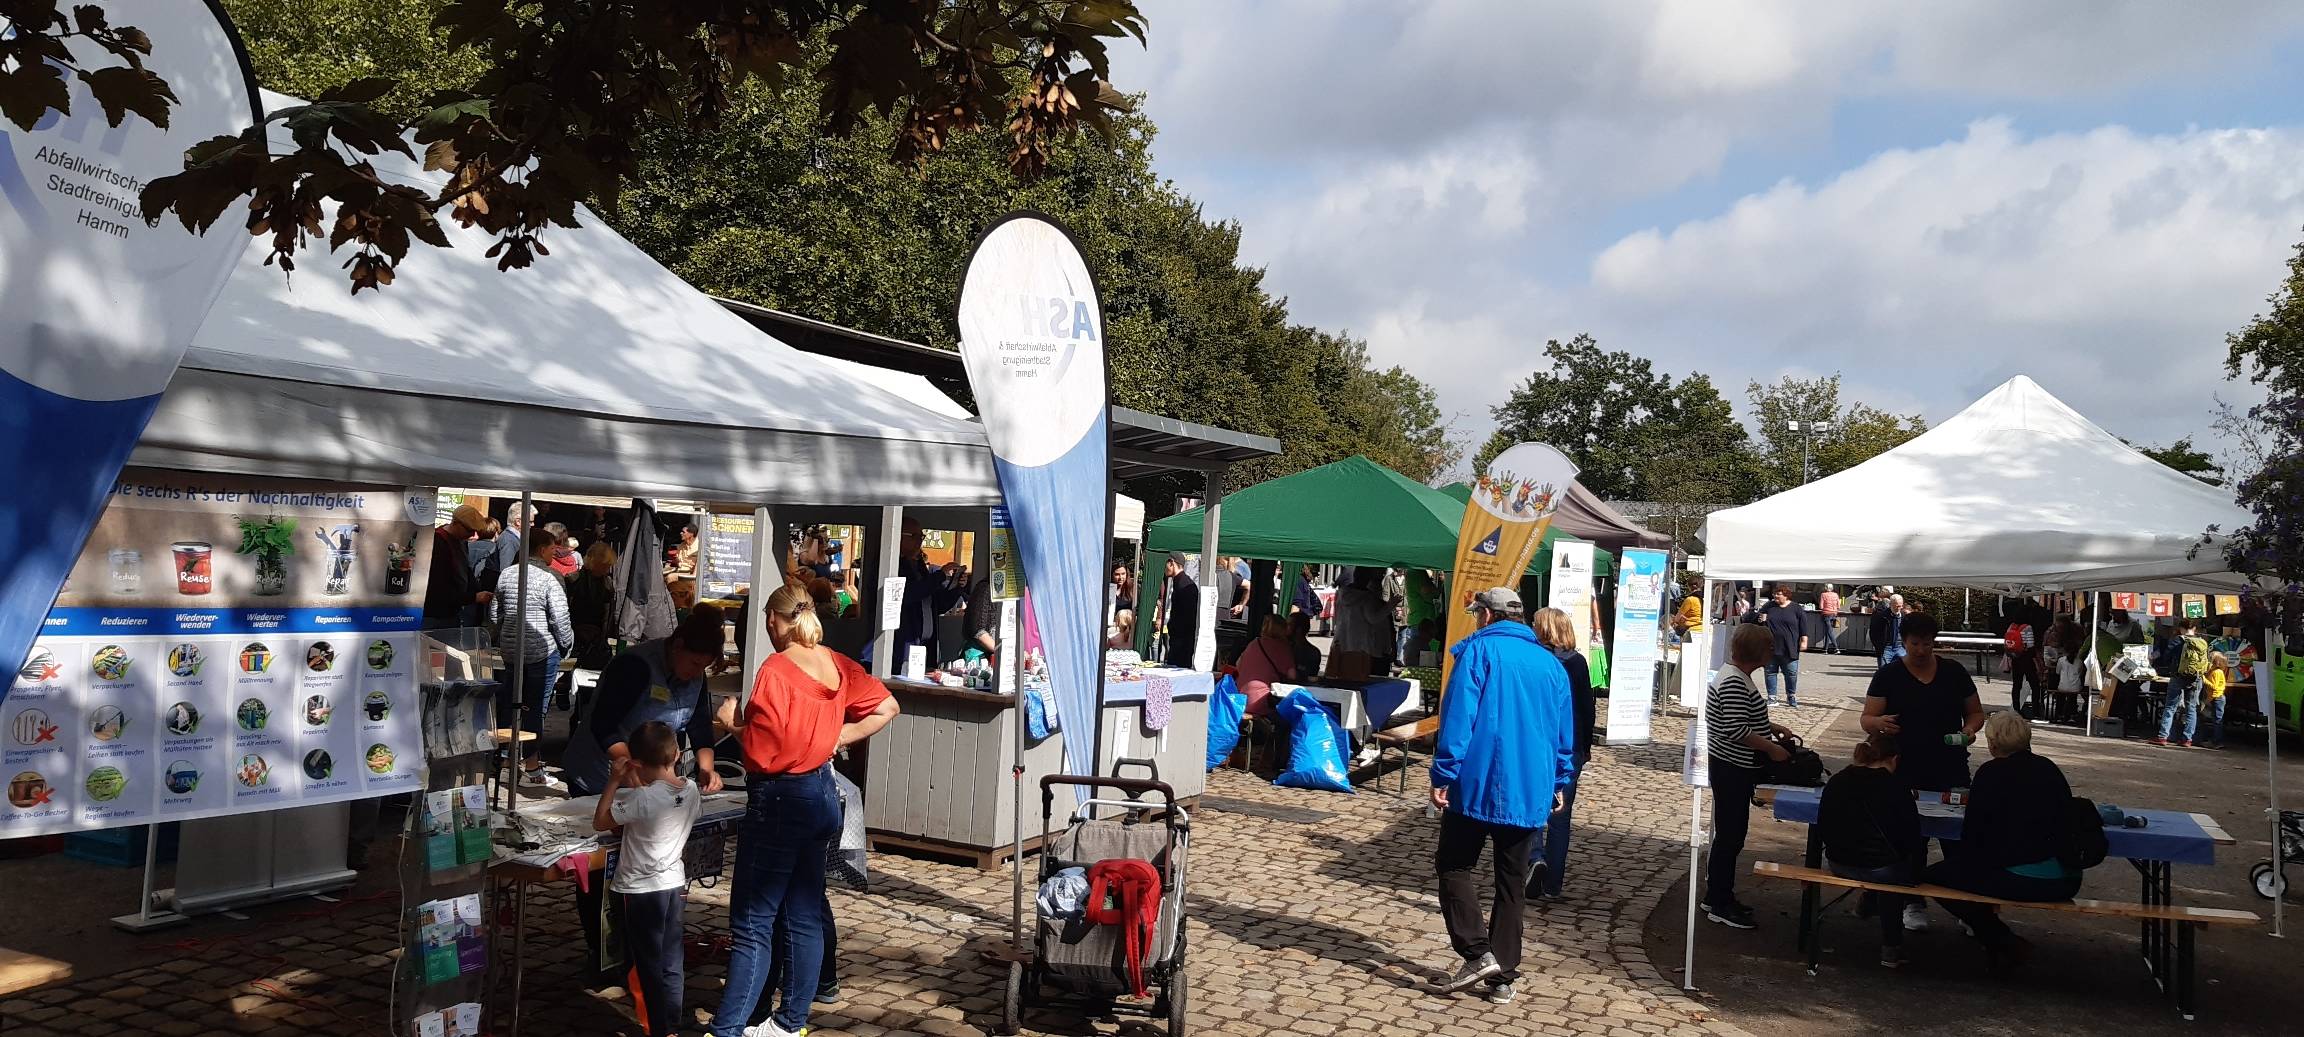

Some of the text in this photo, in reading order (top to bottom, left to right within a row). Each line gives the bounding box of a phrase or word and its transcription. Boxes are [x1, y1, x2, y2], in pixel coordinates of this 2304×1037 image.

[35, 145, 147, 195] Abfallwirtscha
[77, 208, 129, 239] Hamm
[137, 483, 181, 499] sechs
[215, 488, 241, 503] der
[248, 490, 365, 510] Nachhaltigkeit
[180, 572, 210, 583] Reuse
[391, 576, 404, 587] Rot
[45, 617, 68, 626] nnen
[101, 617, 148, 626] Reduzieren
[175, 613, 219, 622] Wiederver-
[246, 613, 287, 622] Wiederver-
[315, 615, 352, 625] Reparieren
[372, 615, 415, 624] Kompostieren
[180, 621, 211, 629] wenden
[252, 620, 278, 628] werten
